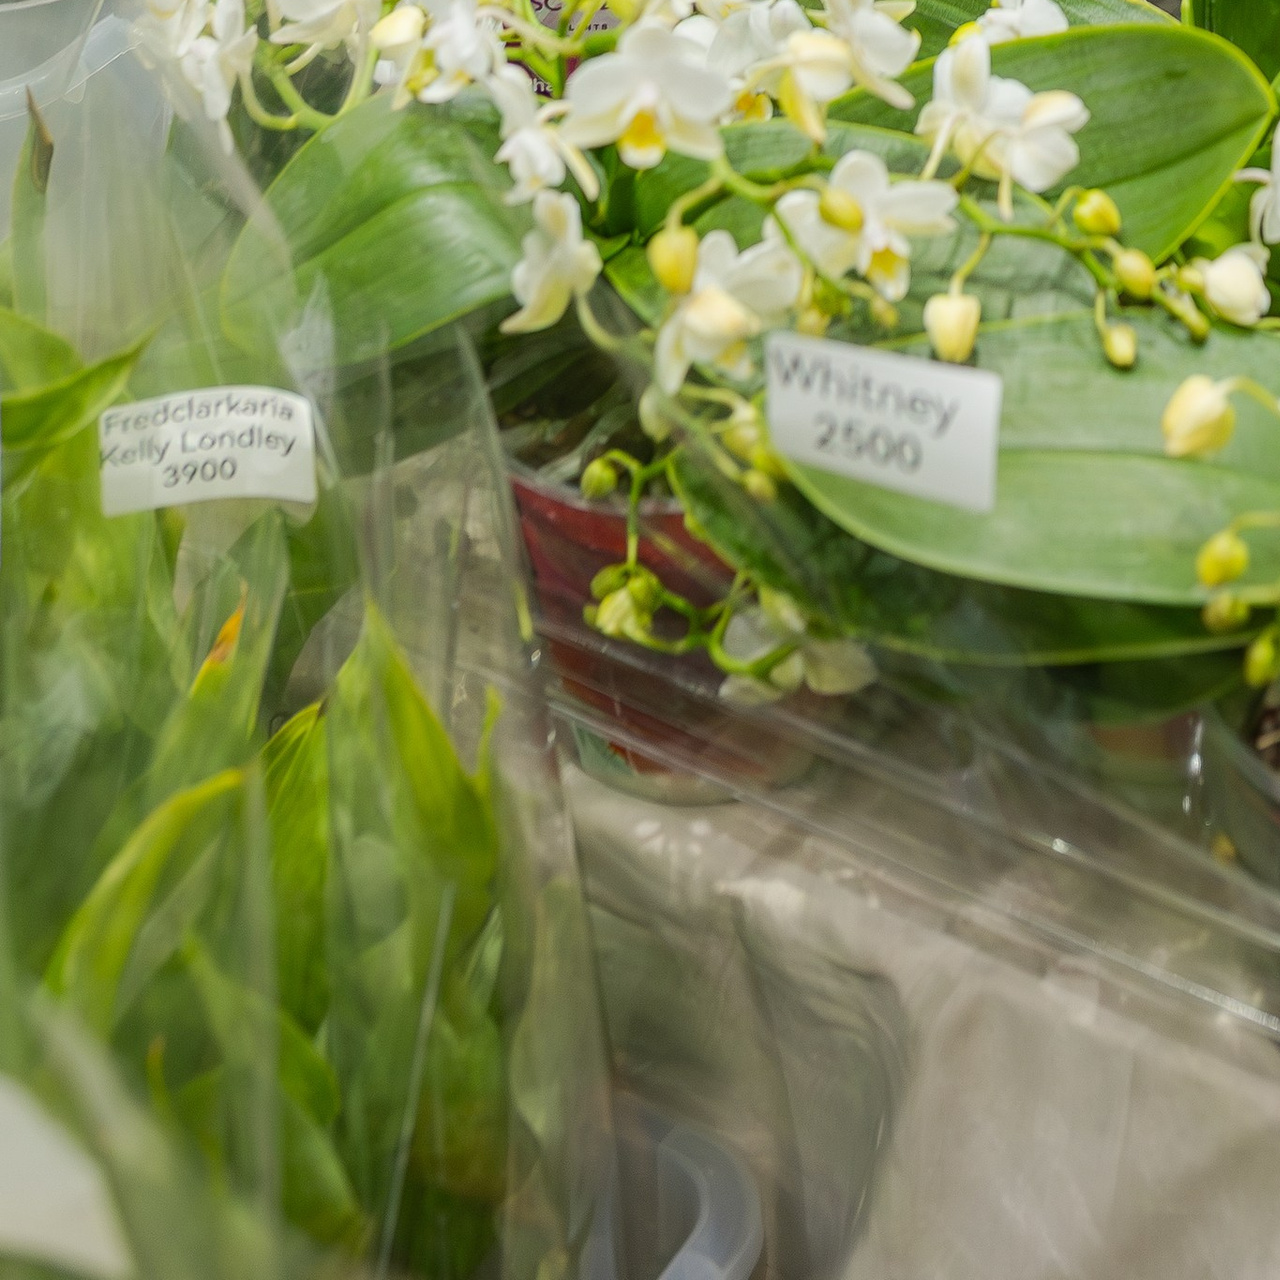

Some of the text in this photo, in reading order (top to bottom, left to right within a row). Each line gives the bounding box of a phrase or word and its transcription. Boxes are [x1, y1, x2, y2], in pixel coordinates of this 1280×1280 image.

[104, 393, 295, 434] Fredclarkaria
[770, 347, 960, 439] Whitney
[181, 424, 296, 457] Londley
[813, 410, 924, 474] 2500
[162, 456, 238, 488] 3900
